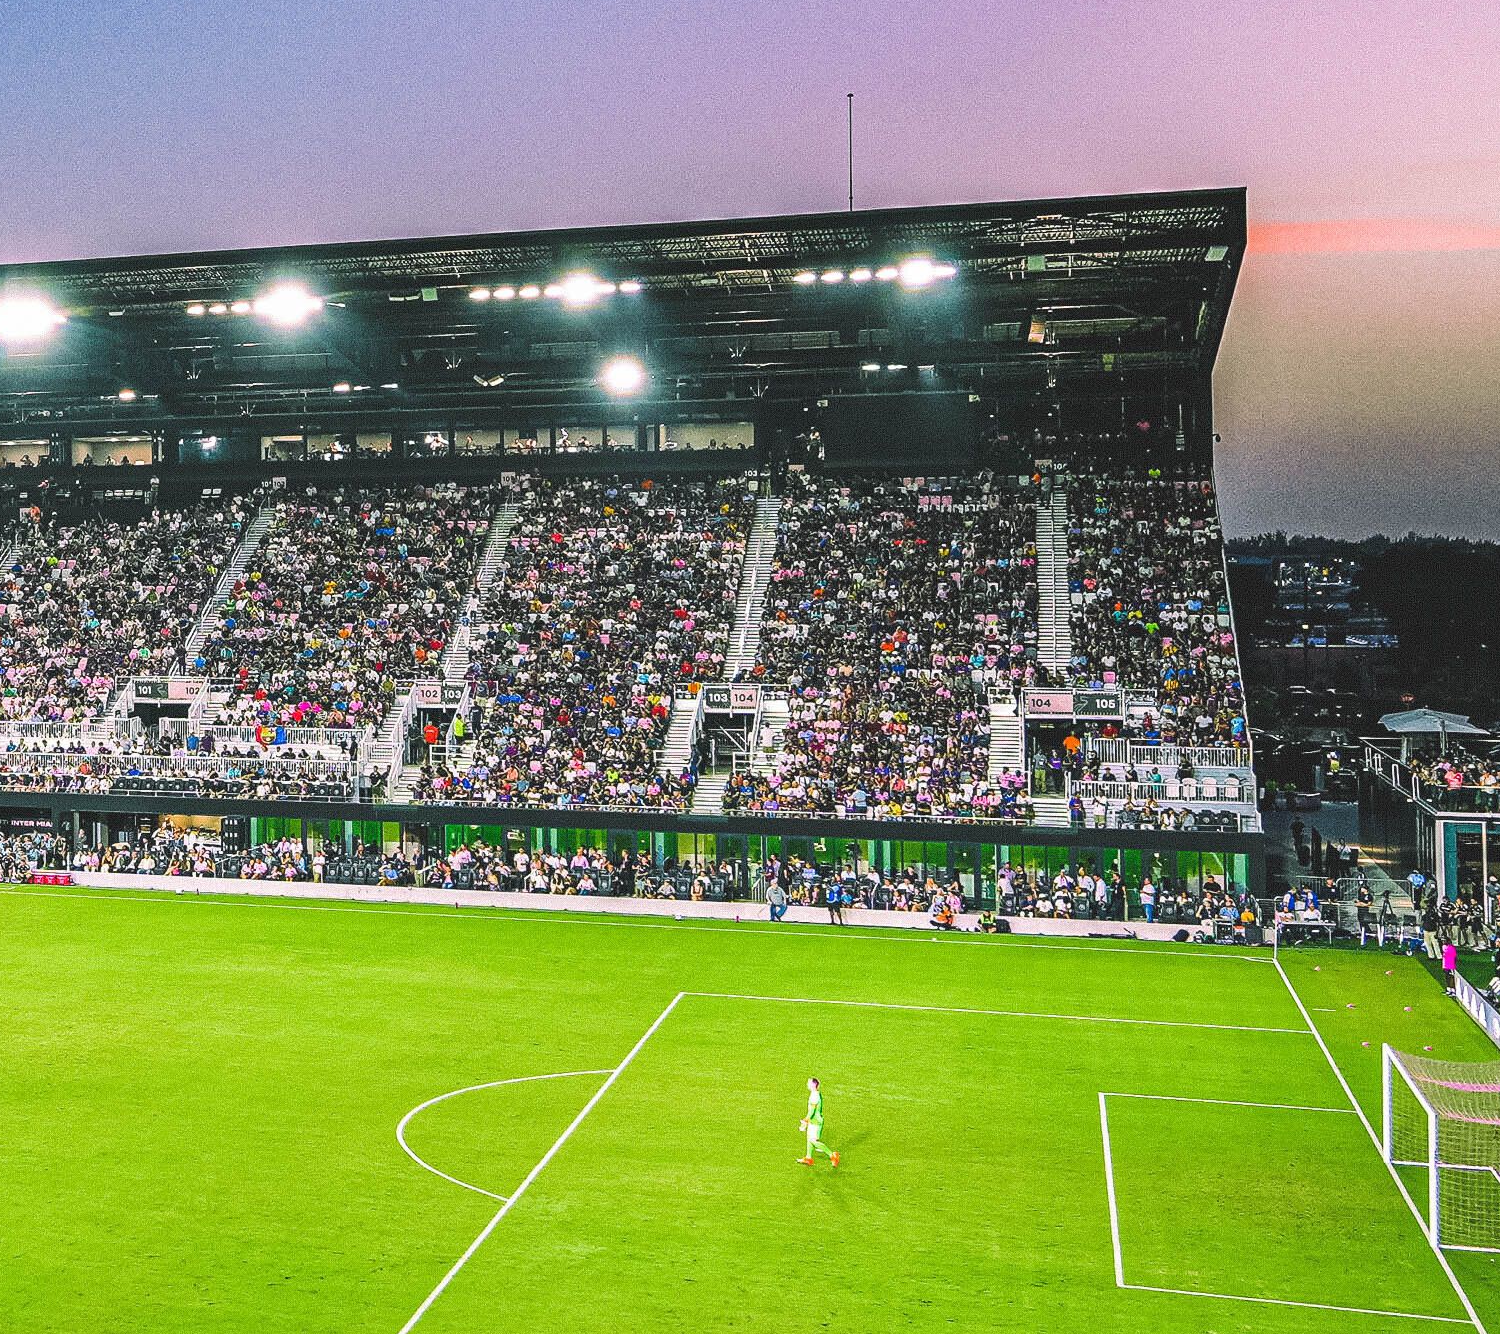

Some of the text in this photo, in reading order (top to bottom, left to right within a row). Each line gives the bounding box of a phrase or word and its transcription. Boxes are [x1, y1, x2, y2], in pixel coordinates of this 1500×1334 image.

[138, 686, 153, 695] 101
[420, 689, 438, 698] 102
[443, 689, 462, 699] 103
[708, 693, 728, 703] 103
[733, 693, 754, 703] 104
[1031, 697, 1052, 708] 104
[1095, 698, 1116, 708] 105
